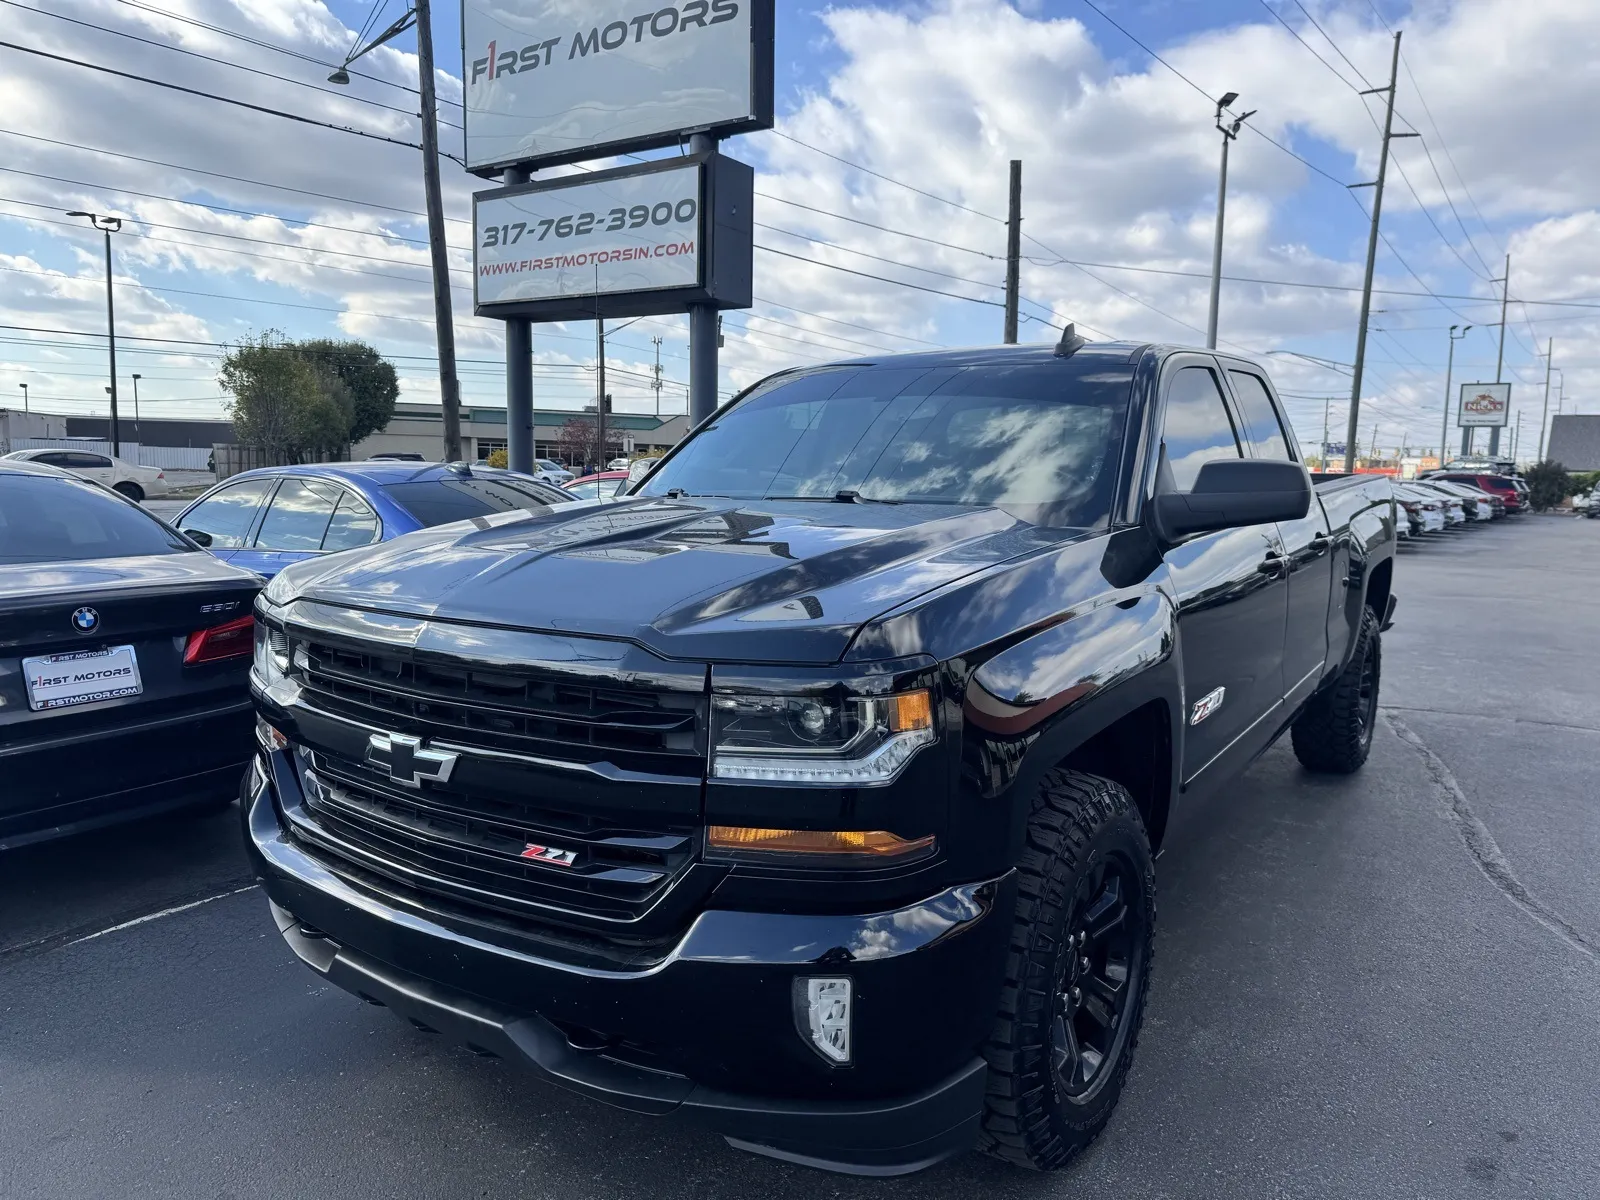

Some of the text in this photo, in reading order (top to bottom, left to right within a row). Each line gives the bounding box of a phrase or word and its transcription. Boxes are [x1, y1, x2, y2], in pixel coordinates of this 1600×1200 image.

[568, 0, 739, 60] MOTORS
[482, 198, 697, 248] 317-762-3900
[479, 241, 694, 276] WWW.FIRSTMOTORSIN.COM
[74, 667, 131, 682] MOTORS
[521, 843, 578, 867] Z71
